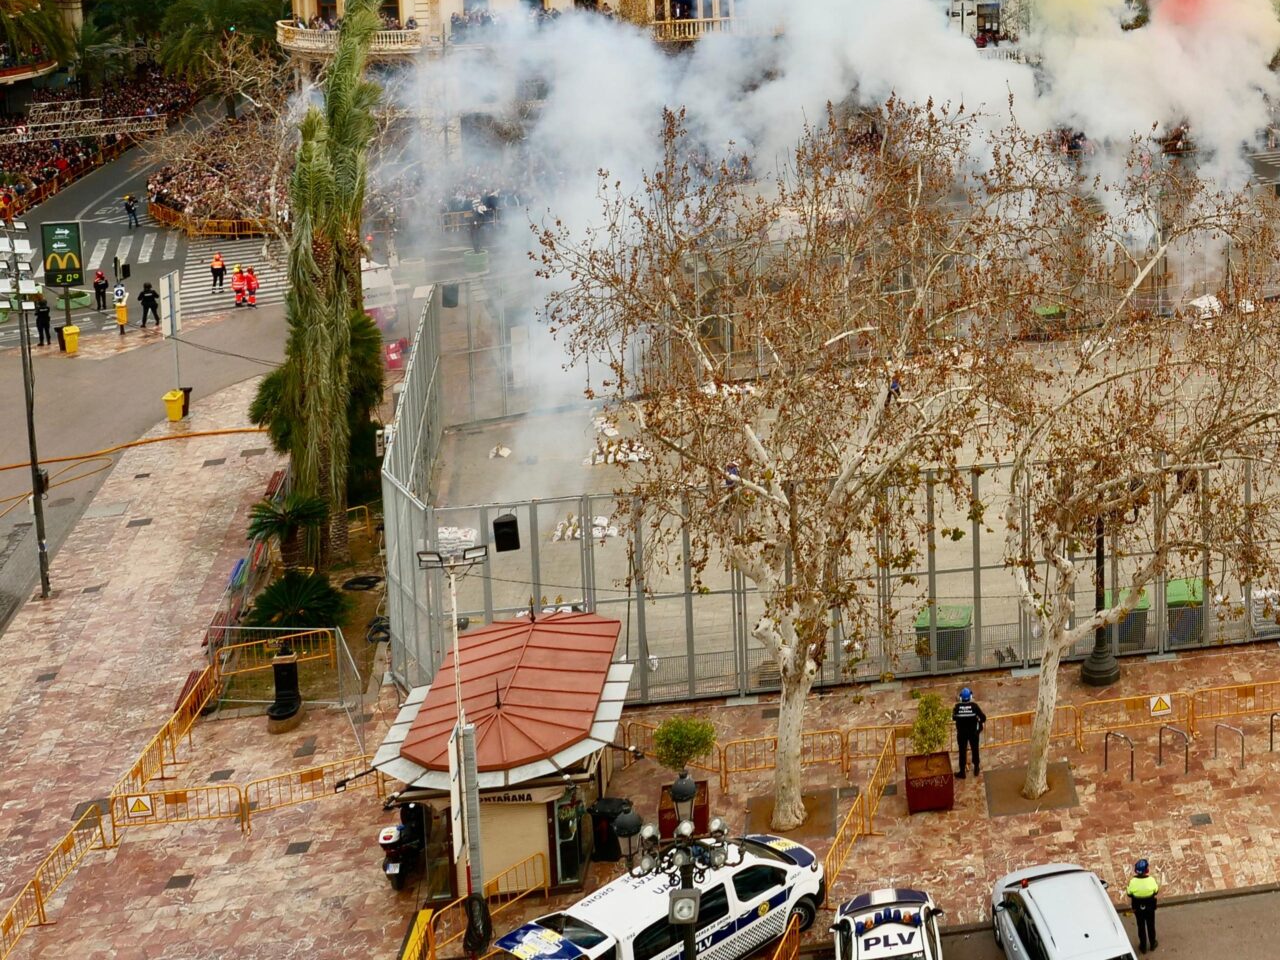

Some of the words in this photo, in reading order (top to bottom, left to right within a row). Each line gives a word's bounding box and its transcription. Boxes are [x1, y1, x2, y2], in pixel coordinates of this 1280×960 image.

[480, 793, 533, 803] ONTAÑANA
[580, 886, 615, 908] DRONS
[863, 931, 916, 952] PLV
[912, 951, 923, 959] PLV
